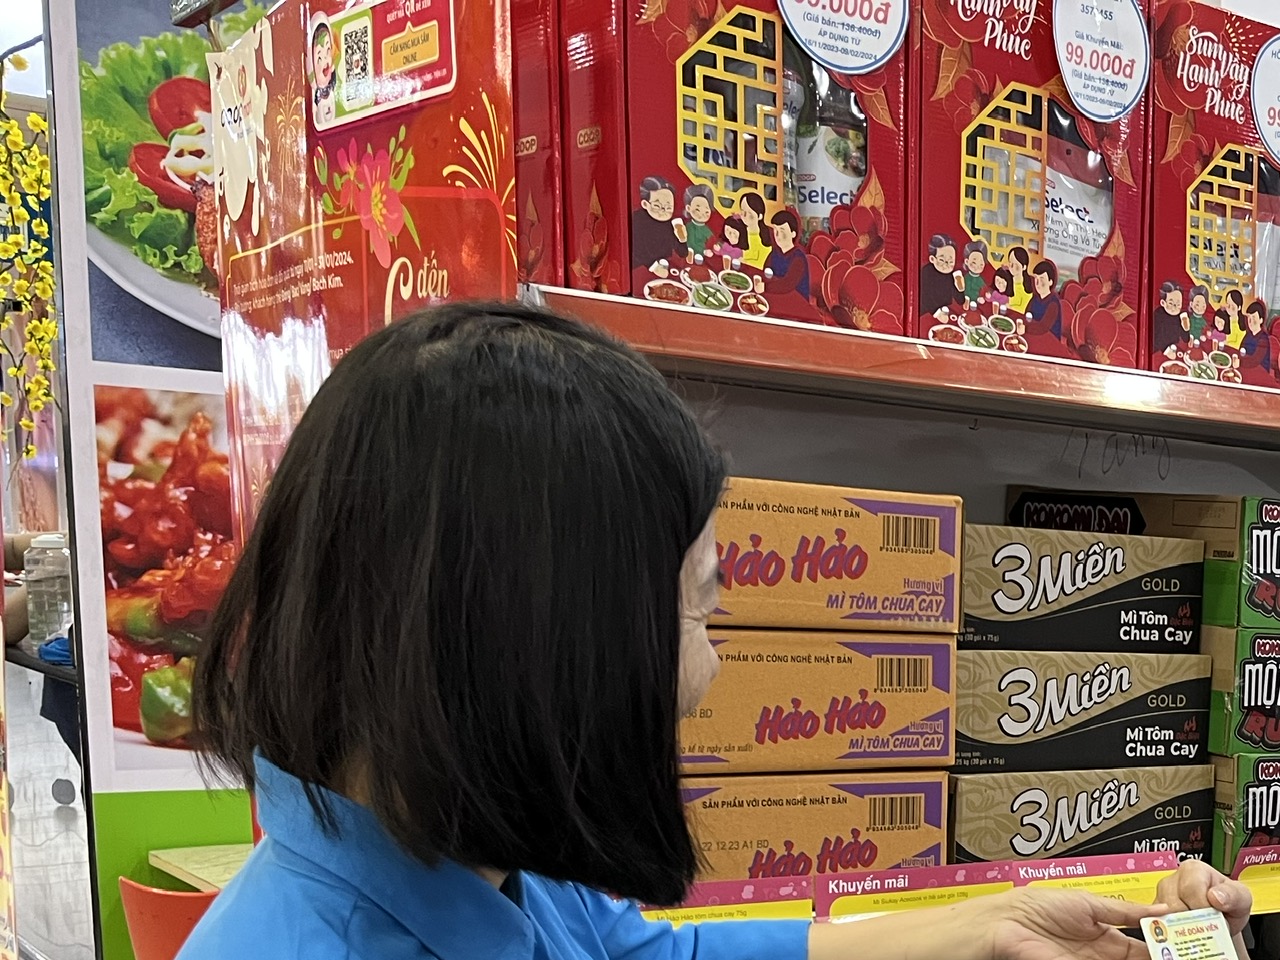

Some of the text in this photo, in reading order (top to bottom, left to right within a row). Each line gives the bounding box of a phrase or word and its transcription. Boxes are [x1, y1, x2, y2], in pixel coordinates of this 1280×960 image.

[818, 28, 861, 46] ÁP DỤNG TỪ
[983, 17, 1033, 61] Phúc
[1065, 41, 1137, 80] 99.000đ
[1176, 51, 1222, 93] Hạnh
[1204, 86, 1246, 125] Phúc
[328, 273, 344, 289] Kim.
[417, 250, 449, 299] đến
[730, 497, 861, 519] PHẨM VỚI CÔNG NGHỆ NHẬT BẢN
[716, 527, 869, 590] Hảo Hảo
[903, 577, 945, 592] Hương vị
[992, 541, 1126, 614] 3 Miền
[1141, 577, 1181, 592] GOLD
[826, 593, 946, 614] MÌ TÔM CHUA CAY
[1120, 608, 1169, 626] Mì Tôm
[1119, 625, 1193, 645] Chua Cay
[725, 651, 853, 666] PHẨM VỚI CÔNG NGHỆ NHẬT BẢN
[998, 662, 1132, 738] 3 Miền
[1147, 694, 1187, 708] GOLD
[754, 688, 887, 746] Hảo Hảo
[908, 719, 944, 733] Hương vị
[1126, 724, 1174, 742] Mì Tôm
[848, 735, 944, 750] MÌ TÔM CHUA CAY
[1125, 741, 1199, 759] Chua Cay
[702, 793, 848, 810] SẢN PHẨM VỚI CÔNG NGHỆ NHẬT BẢN
[1010, 779, 1139, 857] 3 Miền
[1154, 804, 1192, 820] GOLD
[749, 828, 878, 879] Hảo Hảo
[1134, 837, 1180, 854] Mì Tôm
[1243, 852, 1278, 865] Khuyến
[1018, 862, 1088, 879] Khuyến mãi
[828, 874, 909, 896] Khuyến mãi
[1175, 922, 1219, 938] THẺ ĐOÀN VIÊN
